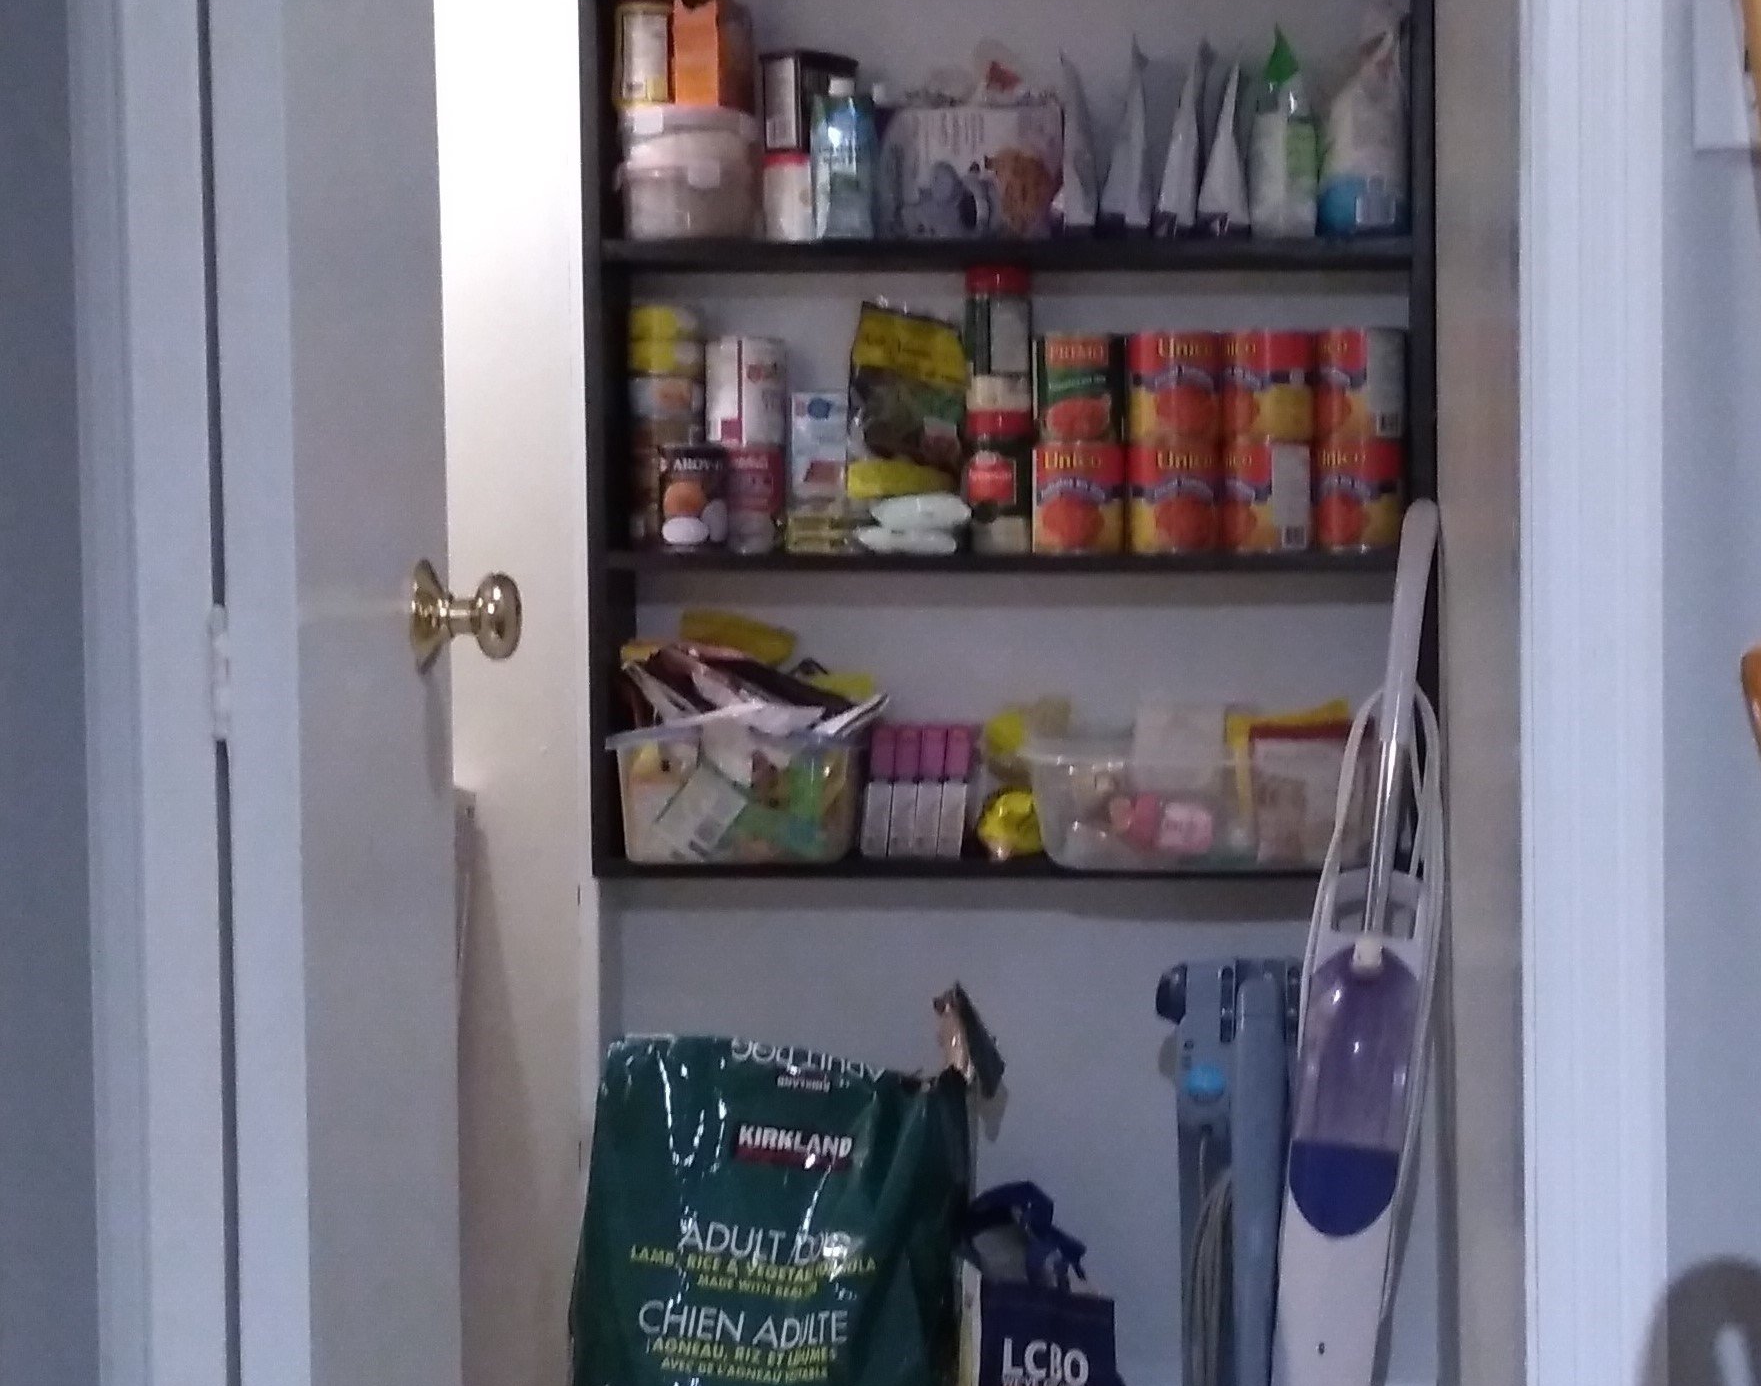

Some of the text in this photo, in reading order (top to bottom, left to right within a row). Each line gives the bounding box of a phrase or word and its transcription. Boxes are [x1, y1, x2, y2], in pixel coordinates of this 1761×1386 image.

[1043, 450, 1101, 470] Unico
[738, 1123, 853, 1159] KIRKLAND
[678, 1216, 787, 1269] ADULT
[639, 1299, 744, 1342] CHIEN
[1003, 1337, 1090, 1386] LCBO
